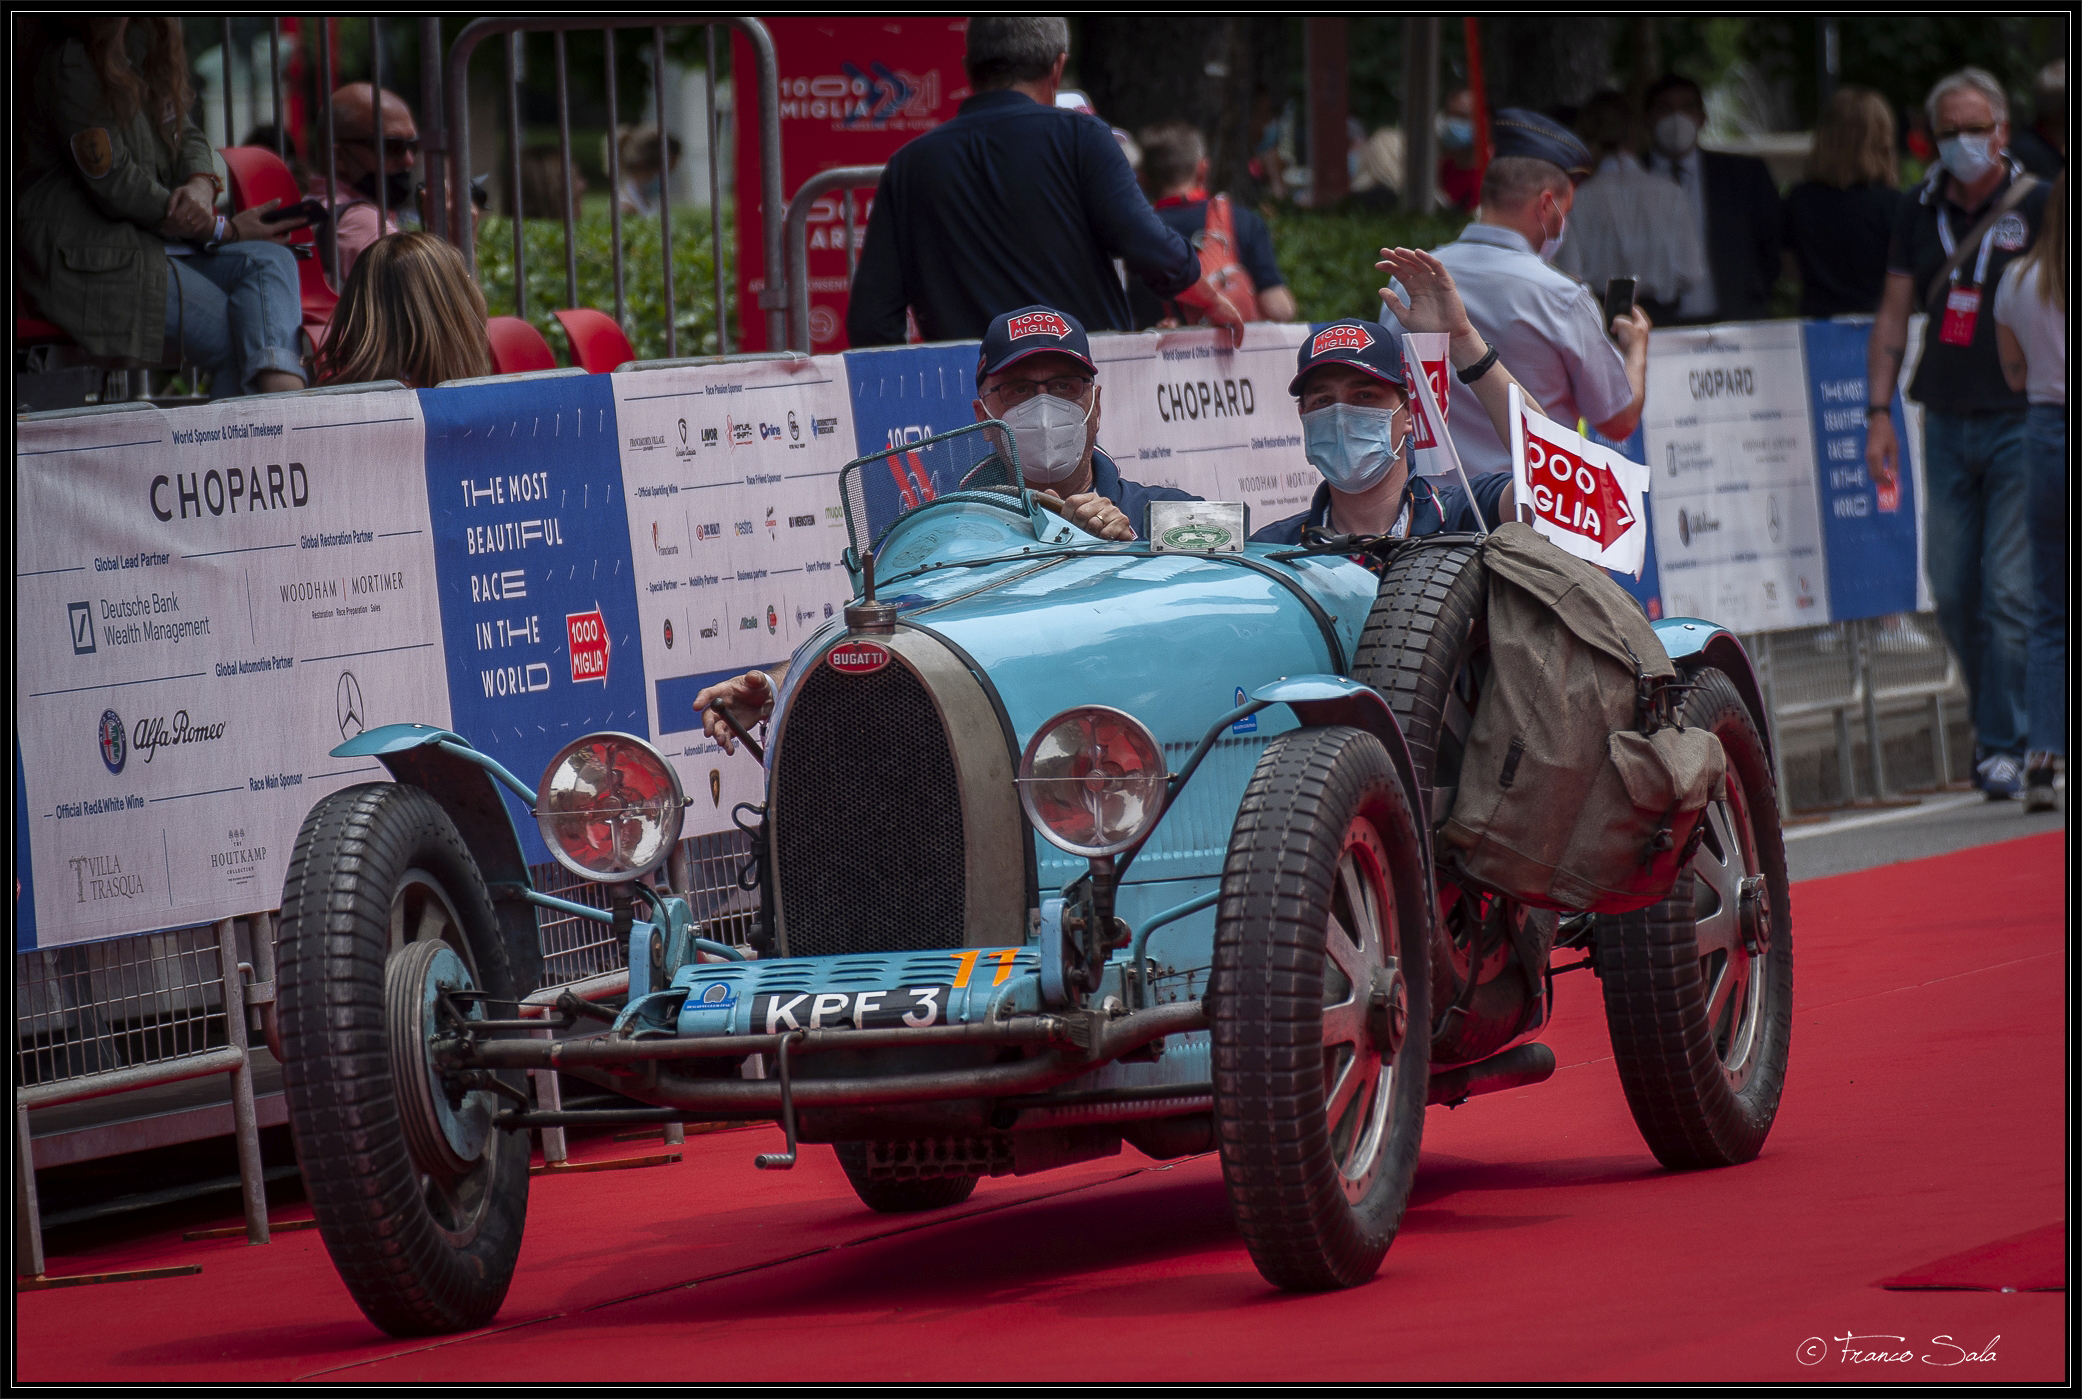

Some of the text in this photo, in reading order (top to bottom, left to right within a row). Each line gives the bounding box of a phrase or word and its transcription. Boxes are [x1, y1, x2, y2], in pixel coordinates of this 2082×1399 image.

[780, 100, 870, 119] MIGLIA
[1014, 324, 1060, 337] MIGLIA
[1016, 314, 1055, 326] 1000
[1315, 338, 1359, 353] MIGLIA
[1320, 328, 1357, 340] 1000
[705, 384, 714, 396] Race
[728, 382, 742, 395] Sponsor
[1688, 367, 1755, 400] CHOPARD
[1157, 378, 1254, 422] CHOPARD
[1823, 407, 1868, 431] BEAUTIF
[172, 423, 283, 446] World Sponsor & Official Timekeeper
[1827, 437, 1857, 460] RACE
[746, 473, 782, 485] Race Friend Sponsor
[1528, 441, 1596, 494] 000
[150, 462, 309, 522] CHOPARD
[461, 472, 548, 508] THE MOST
[638, 483, 678, 498] Official Sparkling Wine
[1238, 476, 1278, 493] WOODHAM
[1532, 484, 1601, 536] GLIA
[1833, 496, 1867, 518] WORLD
[301, 530, 374, 549] Global Restoration Partner
[467, 518, 563, 555] BEAUTIFUL
[94, 551, 170, 572] Global Lead Partner
[805, 560, 831, 574] Sport Partner
[280, 571, 404, 602] WOODHAM MORTIMER
[471, 569, 527, 603] RACE
[689, 574, 718, 588] Mobility Partner
[737, 569, 753, 581] Business
[649, 580, 677, 595] Special Partner
[100, 591, 180, 619] Deutsche Bank
[103, 616, 211, 646] Wealth Management
[475, 615, 541, 651] IN THE
[571, 620, 598, 643] 1000
[700, 627, 714, 639] waze
[215, 655, 294, 677] Global Automotive Partner
[572, 650, 603, 675] MIGLIA
[833, 652, 883, 665] BUGATTI
[481, 662, 550, 698] WORLD
[132, 709, 226, 763] Alfa Romeo
[249, 772, 303, 792] Race Main Sponsor
[56, 794, 144, 820] Official Red&White Wine
[87, 854, 121, 877] VILLA
[211, 846, 267, 867] HOUTKAMP
[90, 874, 144, 901] TRASQUA
[950, 948, 1022, 988] 11
[766, 988, 940, 1034] KPF 3
